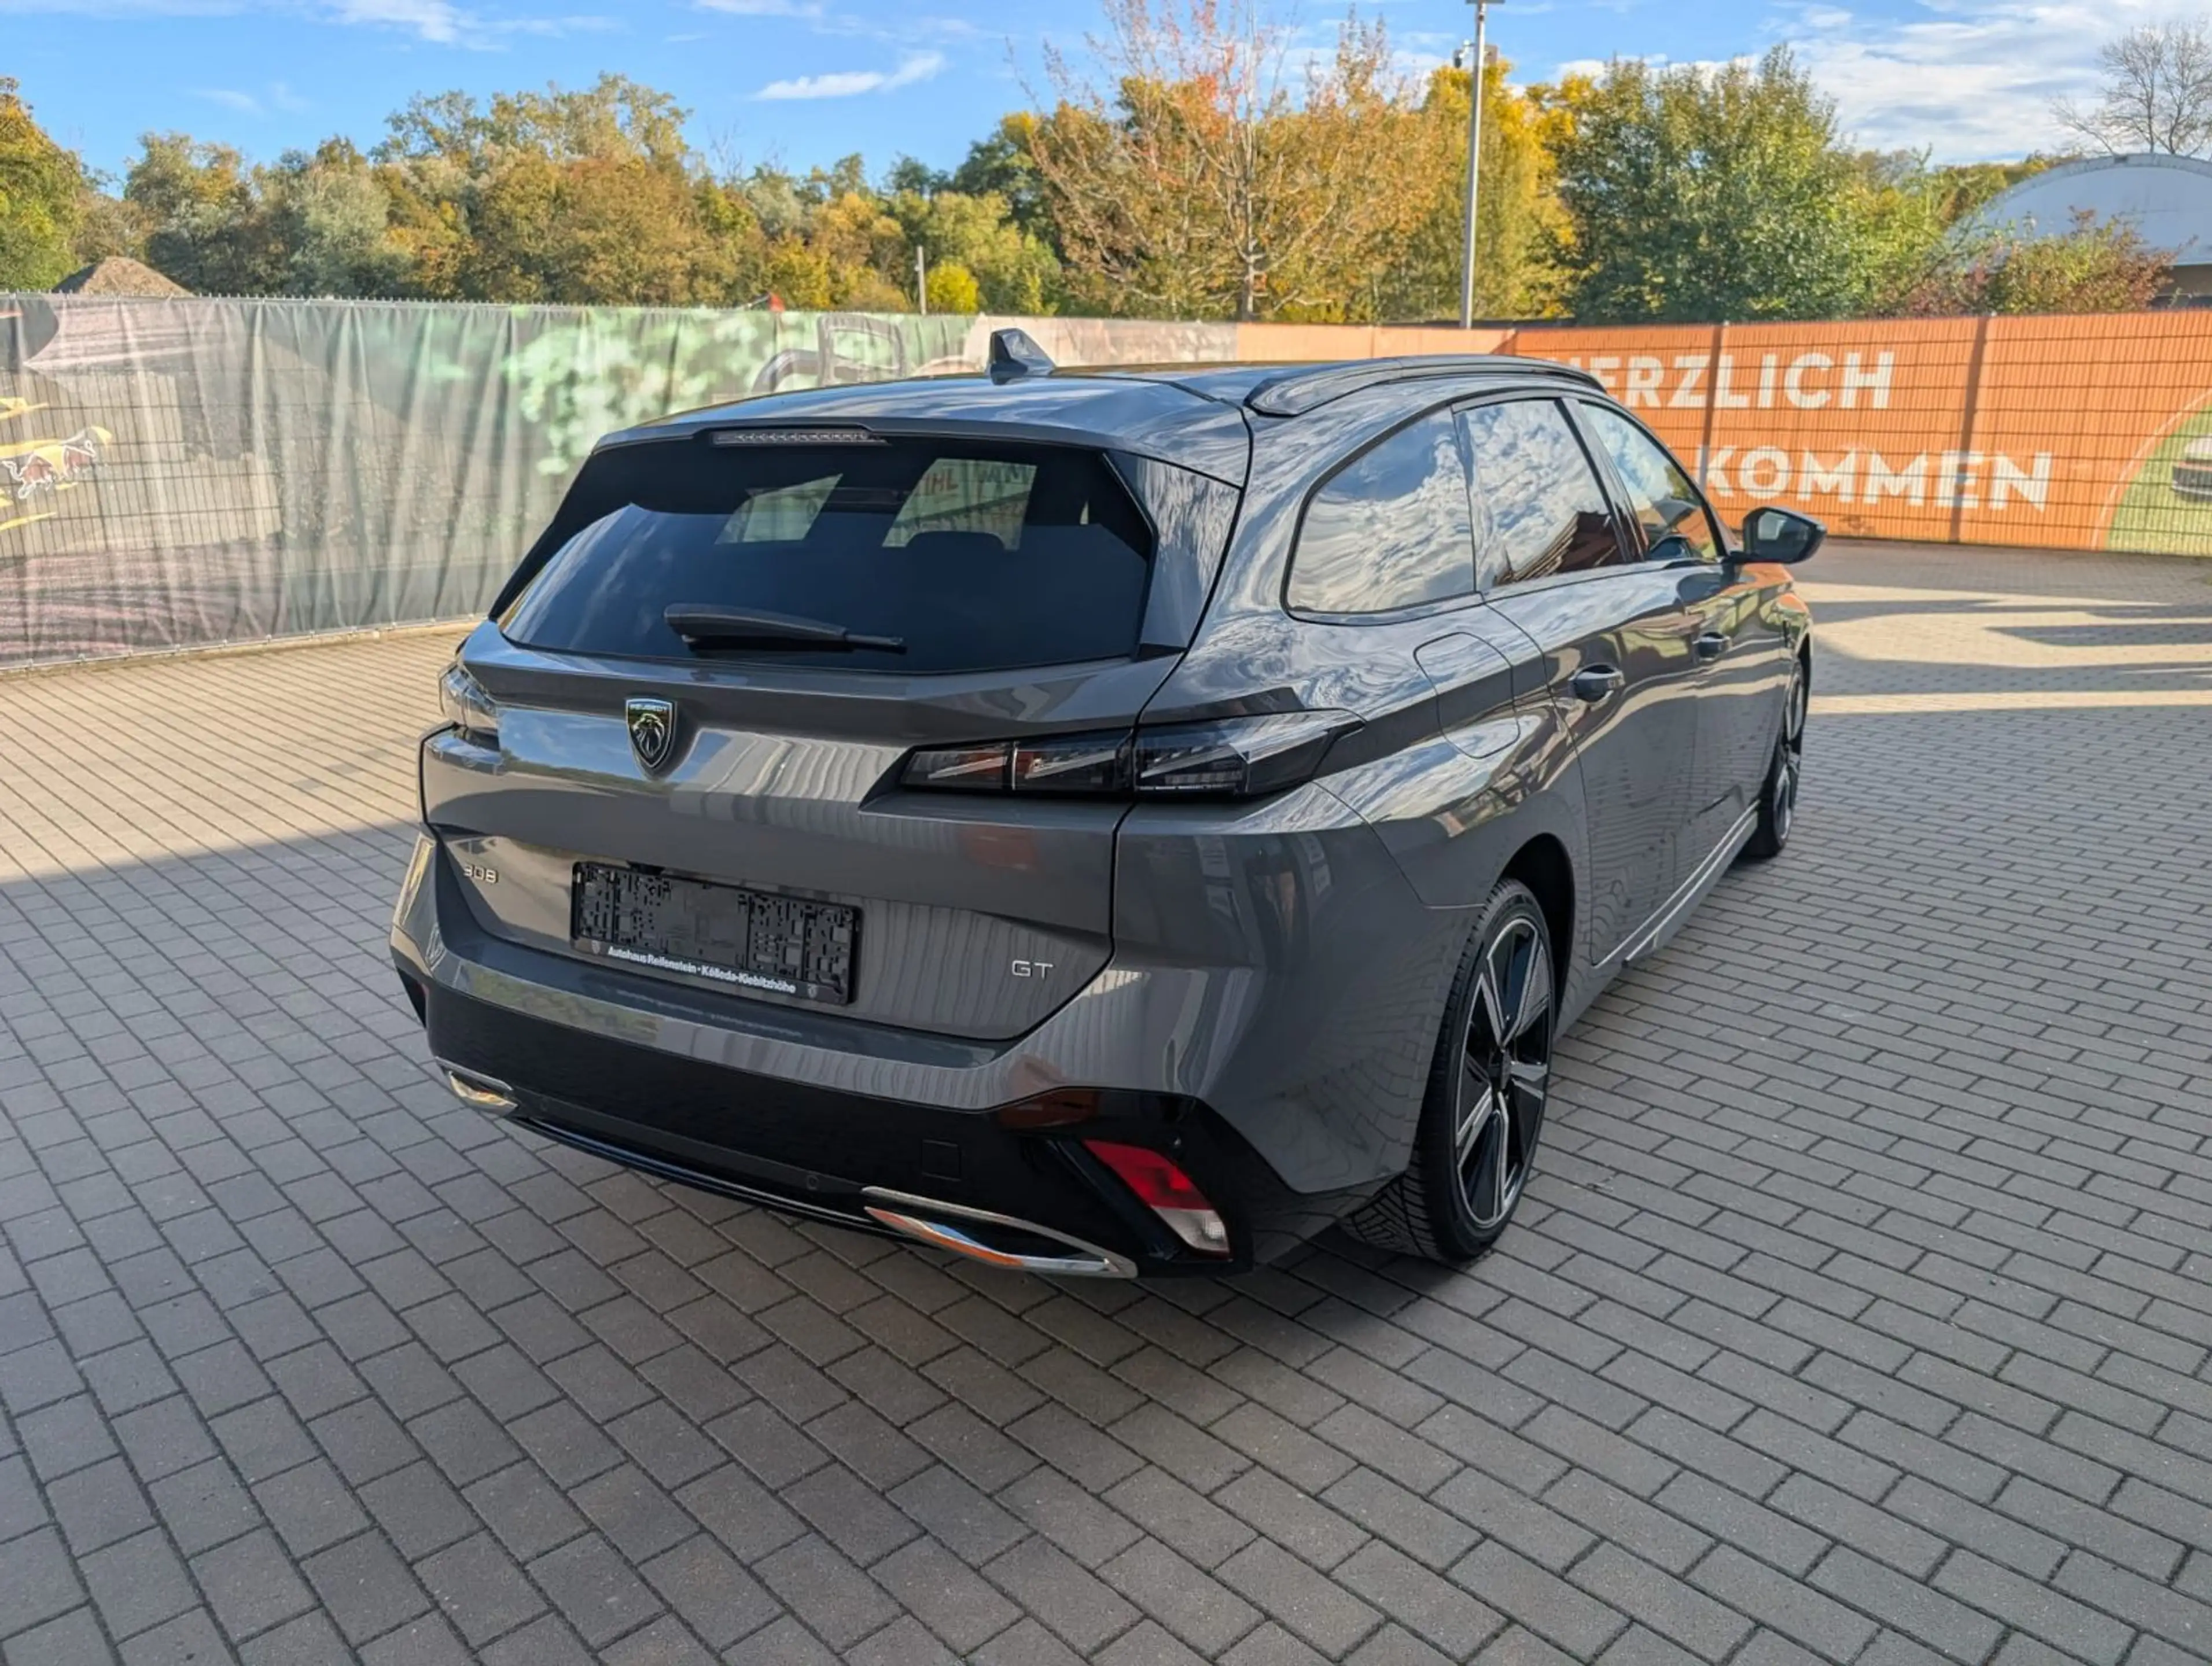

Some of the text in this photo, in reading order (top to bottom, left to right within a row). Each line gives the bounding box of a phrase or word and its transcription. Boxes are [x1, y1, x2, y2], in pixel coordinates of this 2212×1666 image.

[1547, 352, 1894, 409] ERZLICH
[464, 866, 498, 884] 308
[608, 945, 646, 963] Autohaus
[1012, 959, 1054, 979] GT
